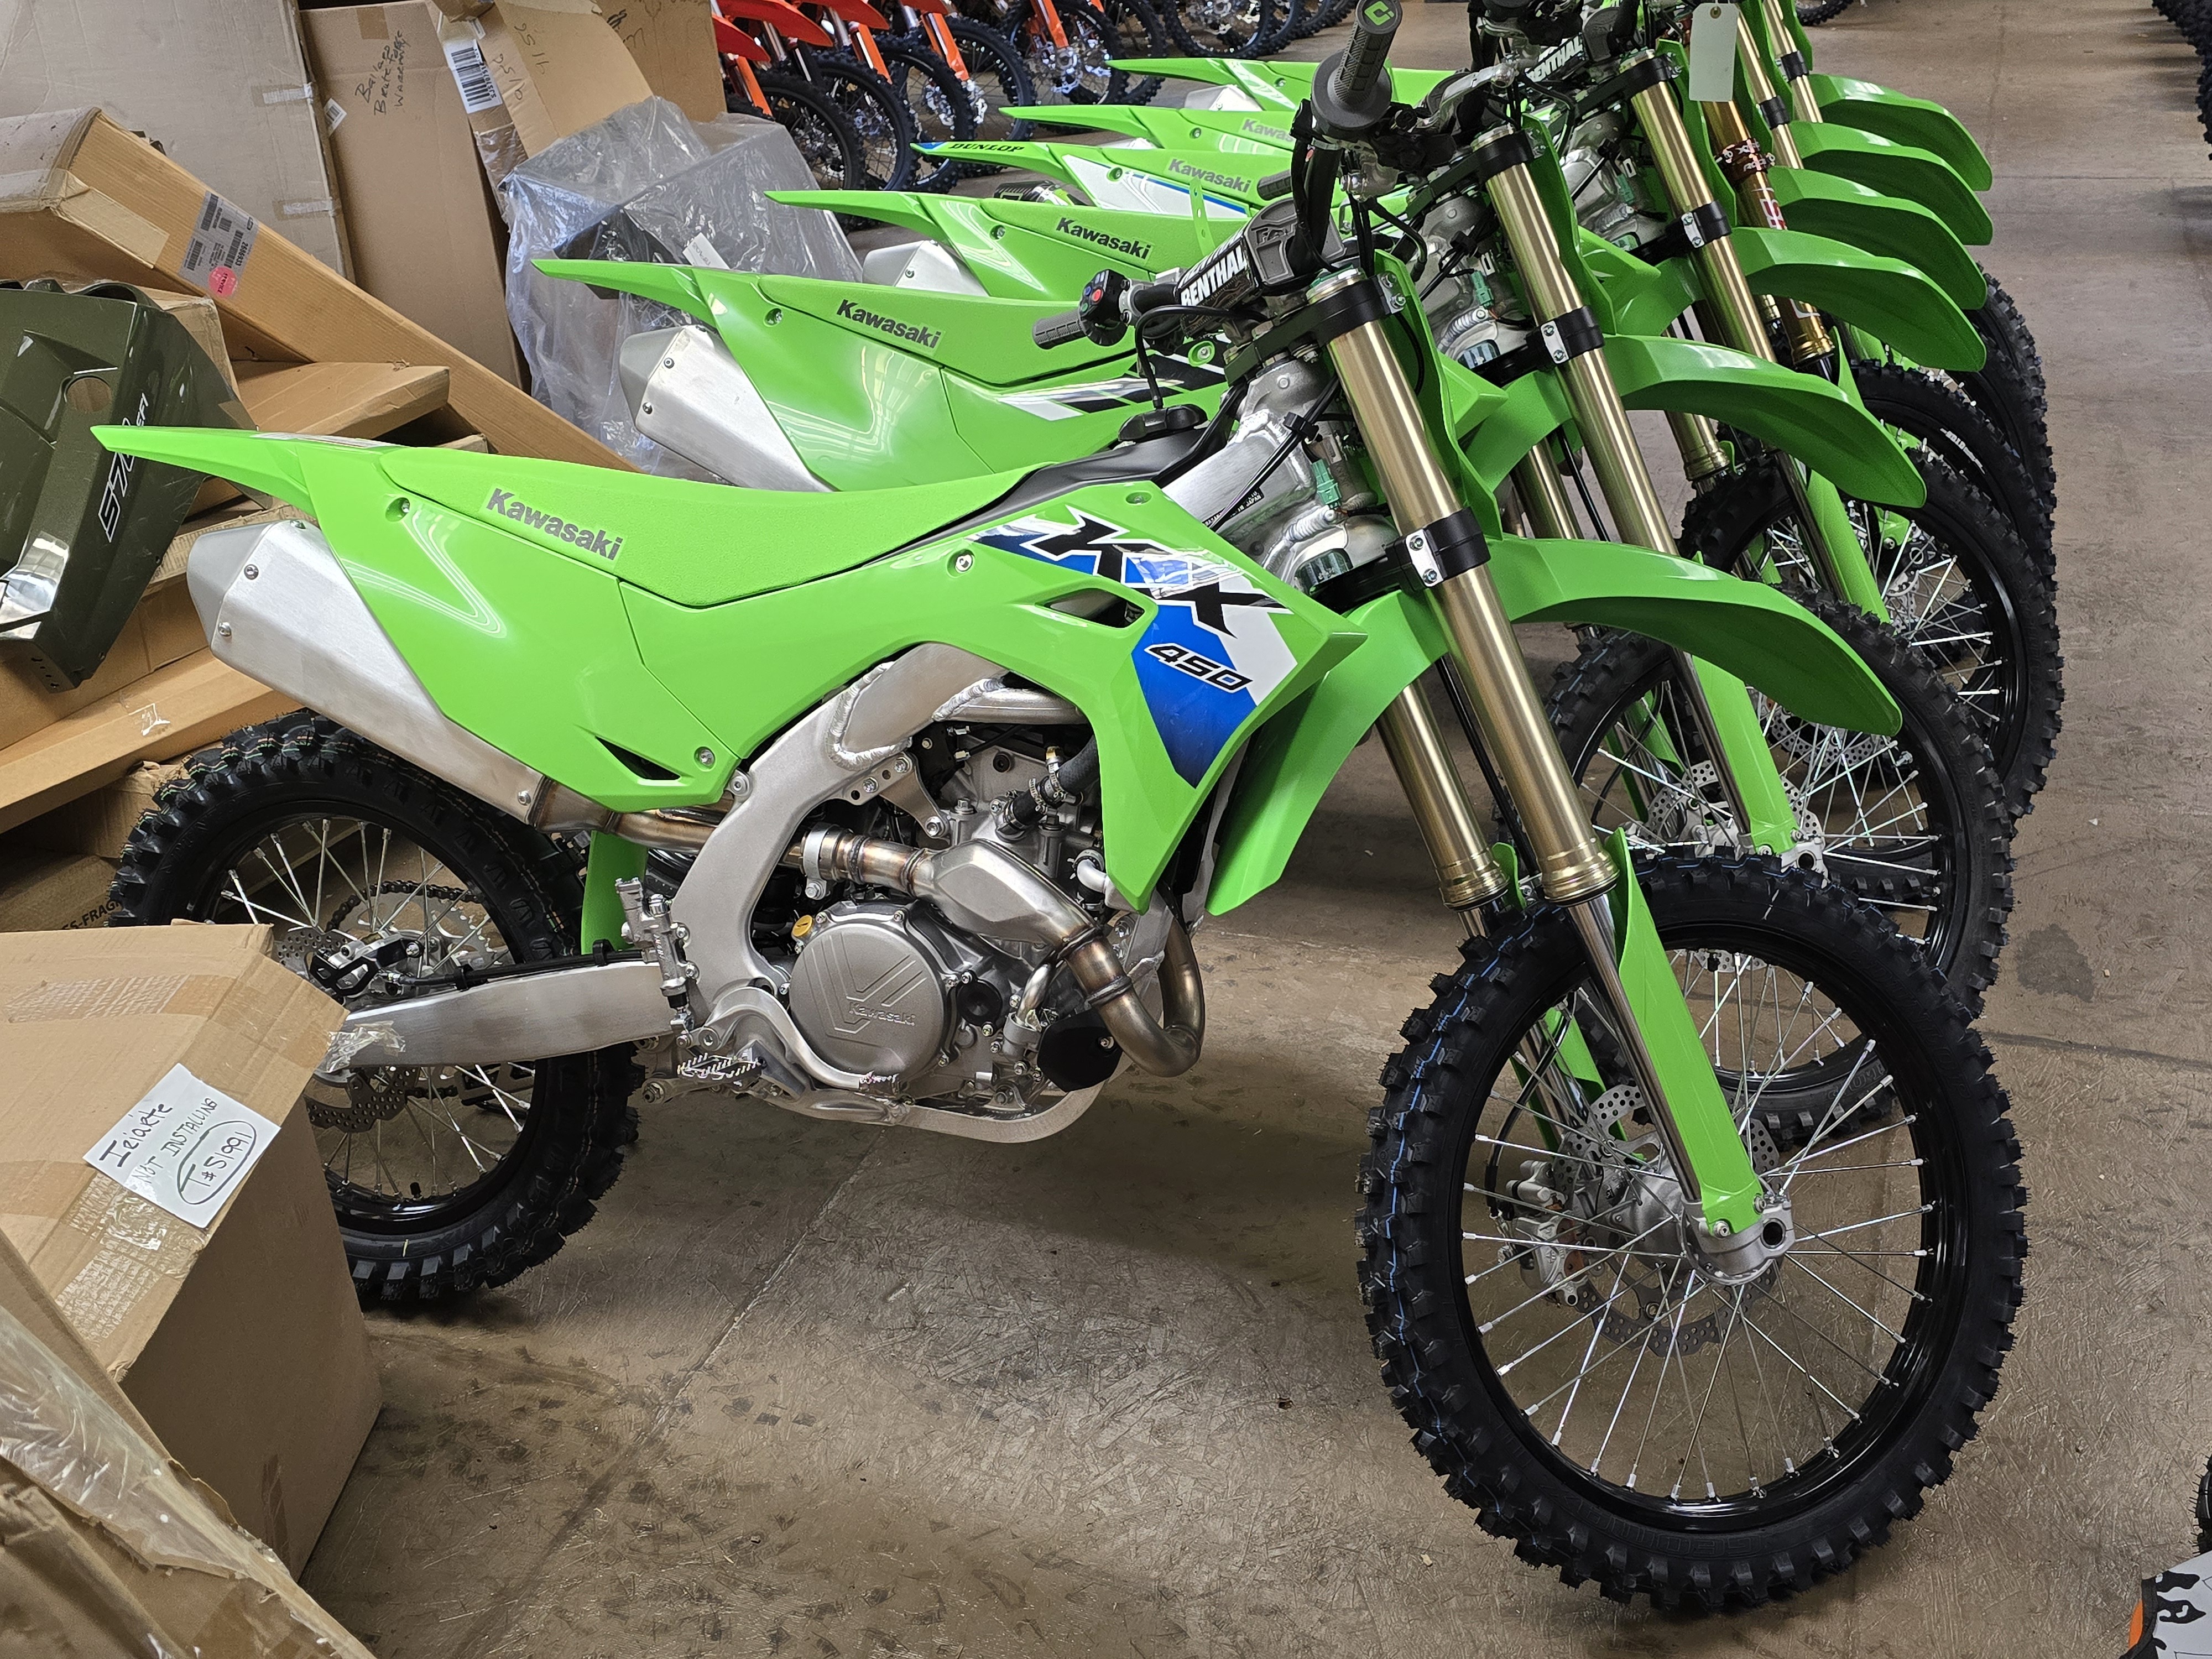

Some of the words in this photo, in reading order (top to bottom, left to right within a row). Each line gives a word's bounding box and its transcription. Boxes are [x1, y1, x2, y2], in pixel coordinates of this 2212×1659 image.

[948, 143, 1025, 152] DUNLOP
[1241, 118, 1294, 142] Kawas
[1168, 158, 1251, 193] Kawasaki
[1056, 217, 1151, 259] Kawasaki
[1180, 242, 1248, 306] RENTHAL
[836, 299, 942, 348] Kawasaki
[1246, 494, 1262, 507] JAPAN
[486, 488, 623, 561] Kawasaki
[1020, 505, 1294, 639] KX
[1144, 643, 1253, 693] 450
[849, 1002, 916, 1026] Kawasaki
[160, 1098, 218, 1157] INSTALLING
